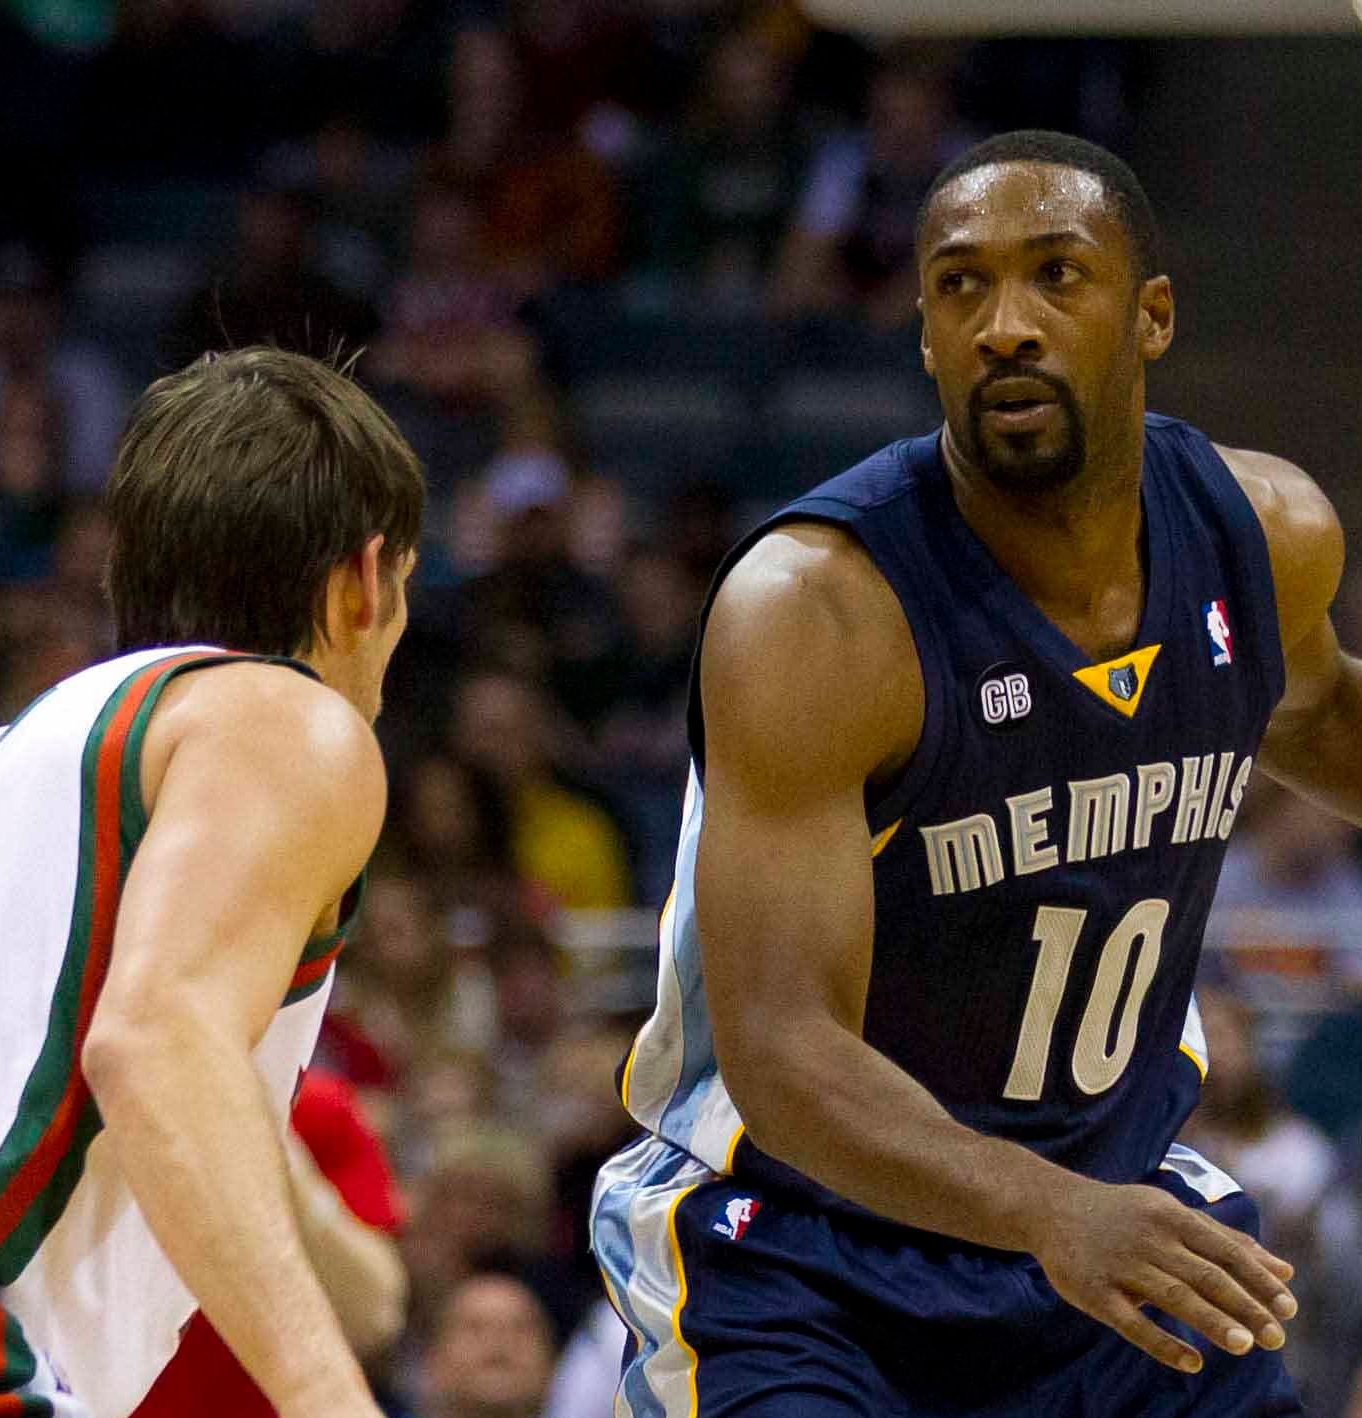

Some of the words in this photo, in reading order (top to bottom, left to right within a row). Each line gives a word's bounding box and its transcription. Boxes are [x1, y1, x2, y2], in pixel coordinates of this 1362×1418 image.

[981, 672, 1032, 724] GB
[918, 752, 1253, 896] MEMPHIS
[1002, 898, 1170, 1101] 10
